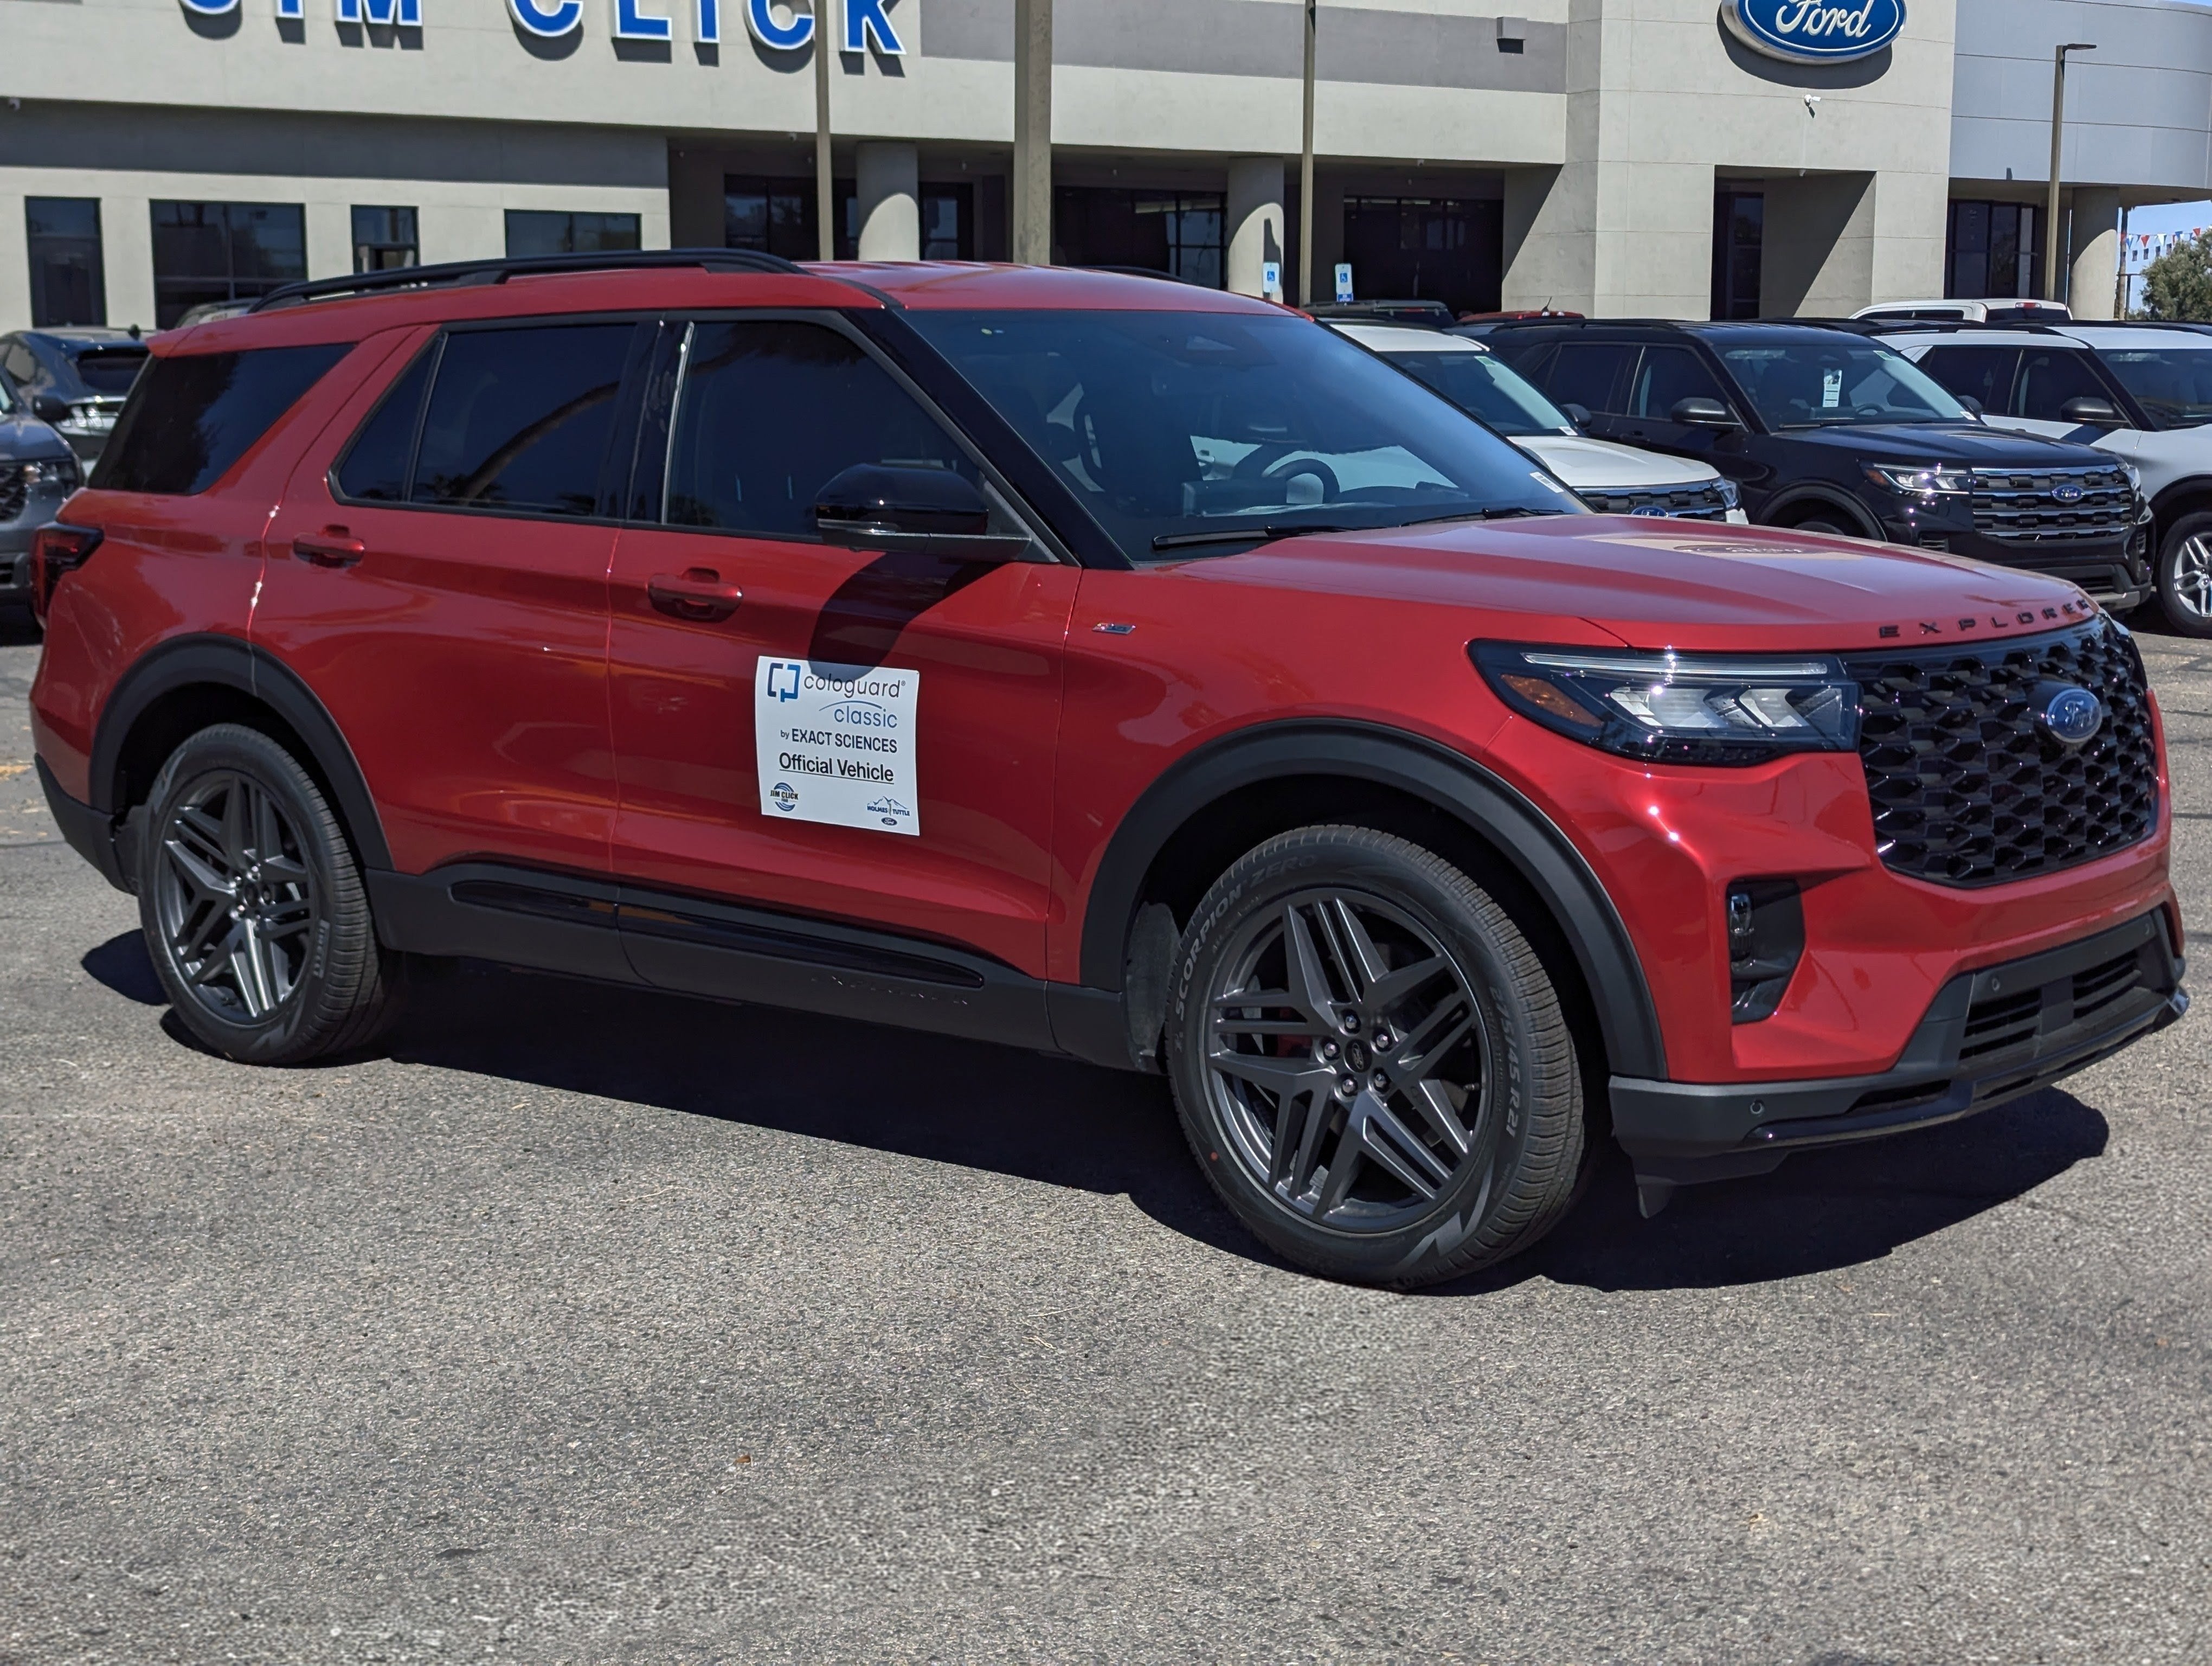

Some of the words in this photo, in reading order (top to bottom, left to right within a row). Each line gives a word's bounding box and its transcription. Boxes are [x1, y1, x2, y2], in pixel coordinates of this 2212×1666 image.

[1776, 0, 1872, 38] Ford
[834, 706, 898, 728] classic
[780, 729, 789, 740] by
[792, 728, 832, 745] EXACT
[834, 733, 898, 753] SCIENCES
[779, 752, 833, 774] Official
[837, 759, 894, 781] Vehicle
[1176, 884, 1242, 1021] SCORPION
[1250, 855, 1316, 888] ZERO
[1489, 986, 1521, 1084] 275/45
